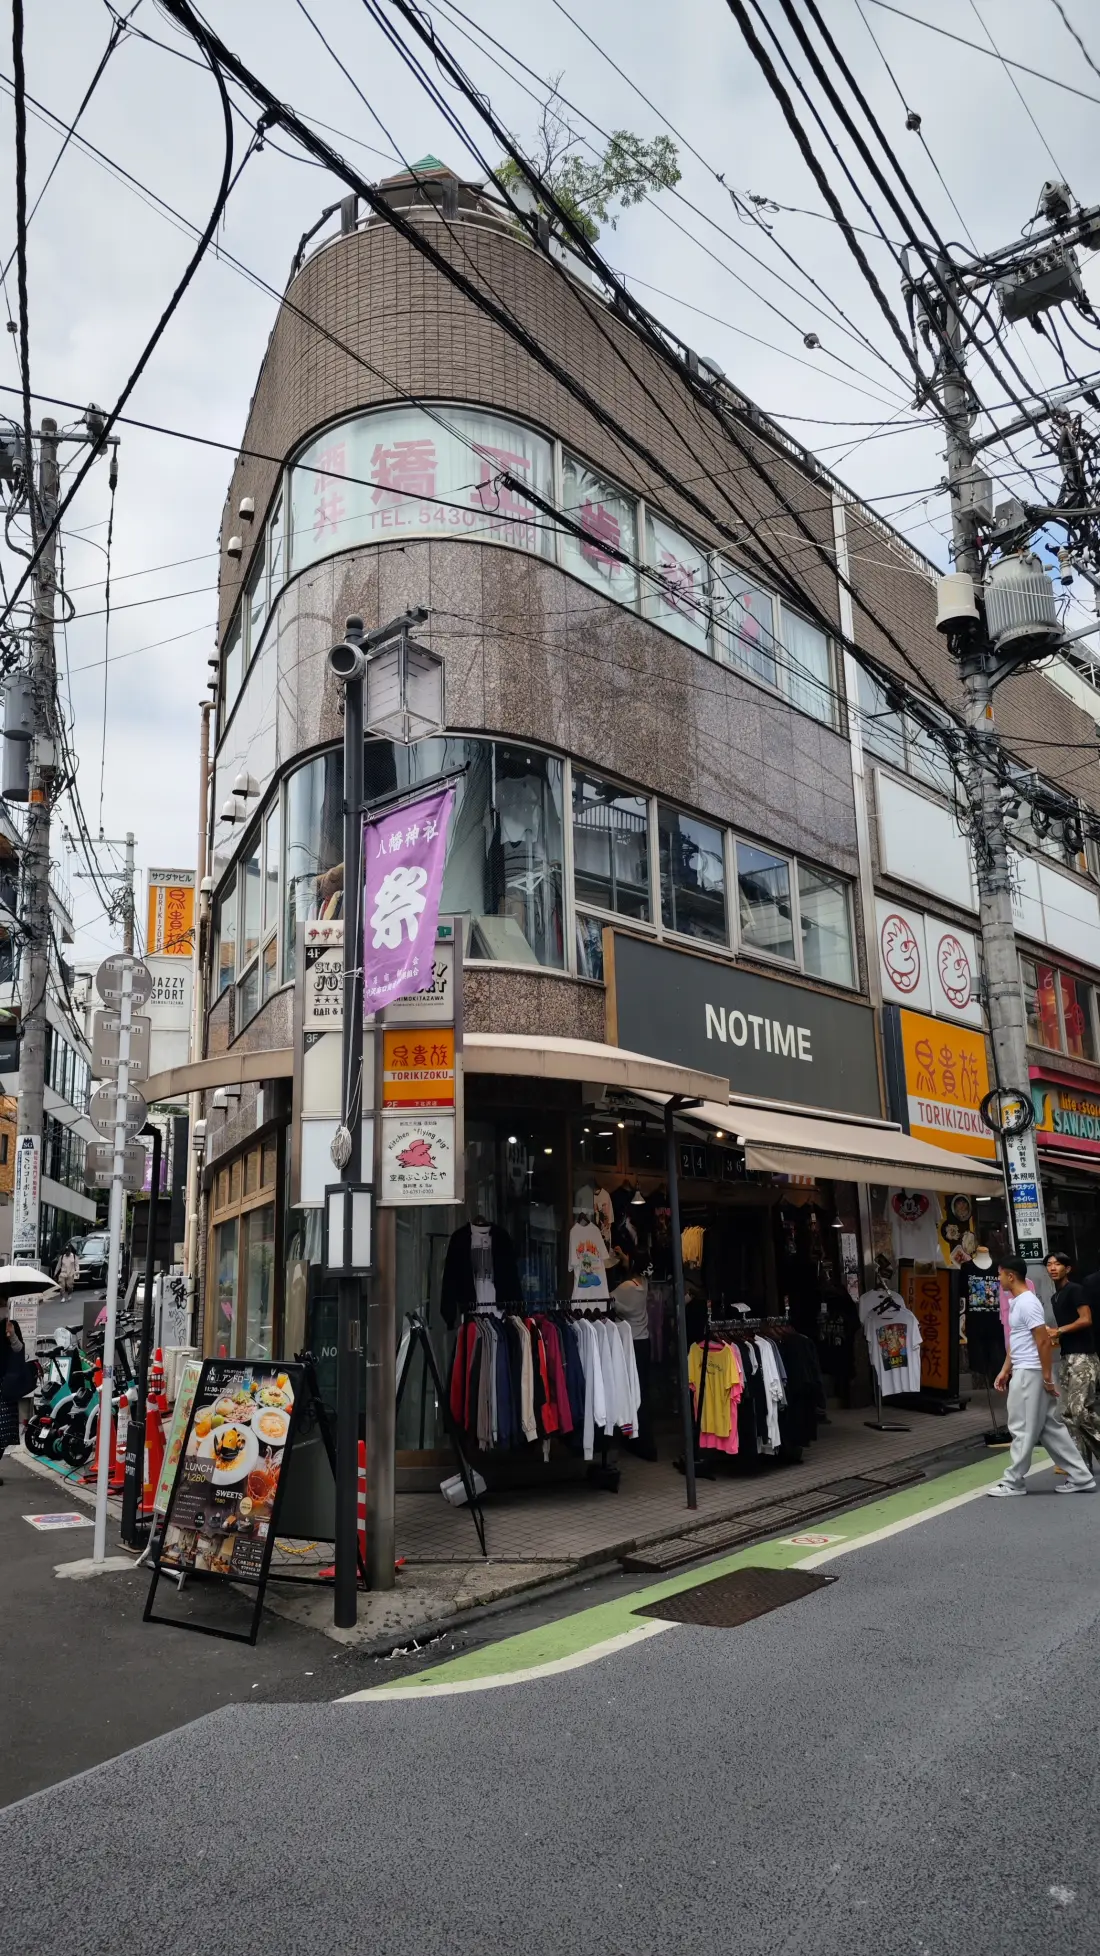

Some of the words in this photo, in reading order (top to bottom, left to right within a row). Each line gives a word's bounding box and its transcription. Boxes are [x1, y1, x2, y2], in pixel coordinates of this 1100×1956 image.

[375, 819, 440, 859] 八幡神社
[151, 872, 193, 883] サワダヤビル
[369, 866, 428, 950] 祭
[307, 949, 321, 958] 4F
[152, 976, 185, 988] JAZZY
[150, 988, 185, 1000] SPORT
[306, 1033, 318, 1043] 3F
[705, 1003, 813, 1062] NOTIME
[391, 1071, 448, 1081] TORIKIZOKU
[917, 1101, 985, 1134] TORIKIZOKU
[388, 1127, 410, 1151] Kitchen
[1012, 1172, 1035, 1181] 本照明
[184, 1462, 214, 1474] LUNCH
[215, 1489, 244, 1500] SWEETS
